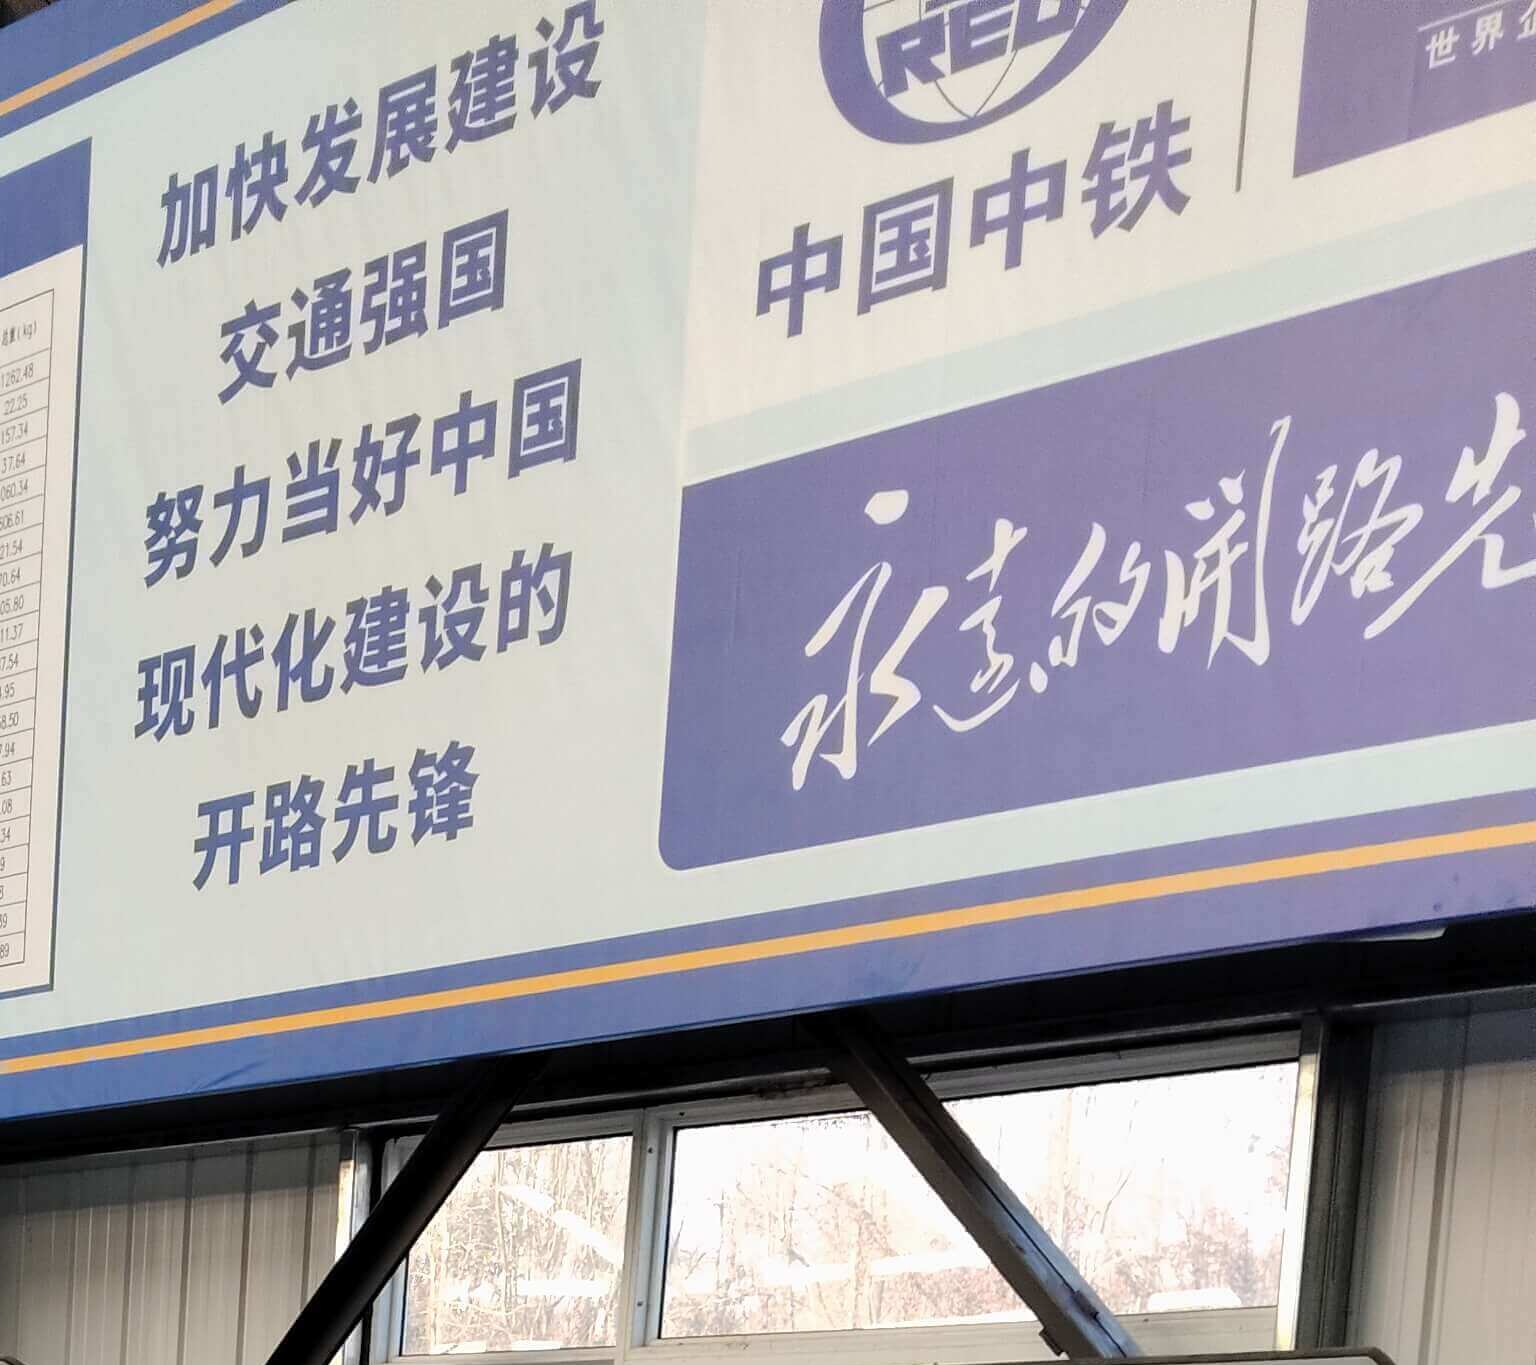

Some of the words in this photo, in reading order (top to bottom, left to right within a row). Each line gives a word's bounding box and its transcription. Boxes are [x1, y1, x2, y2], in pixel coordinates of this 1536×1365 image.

[156, 1, 606, 268] 加快发展建设
[755, 99, 1194, 339] 中国中铁
[1, 361, 33, 389] 1262.48
[218, 209, 510, 404] 交通强国
[1, 419, 28, 445] 157.34
[1, 449, 26, 474] 37.64
[3, 391, 28, 416] 22.25
[144, 358, 583, 588] 努力当好中国
[0, 537, 23, 560] 21.54
[134, 541, 573, 743] 现代化建设的
[193, 740, 481, 892] 开路先锋
